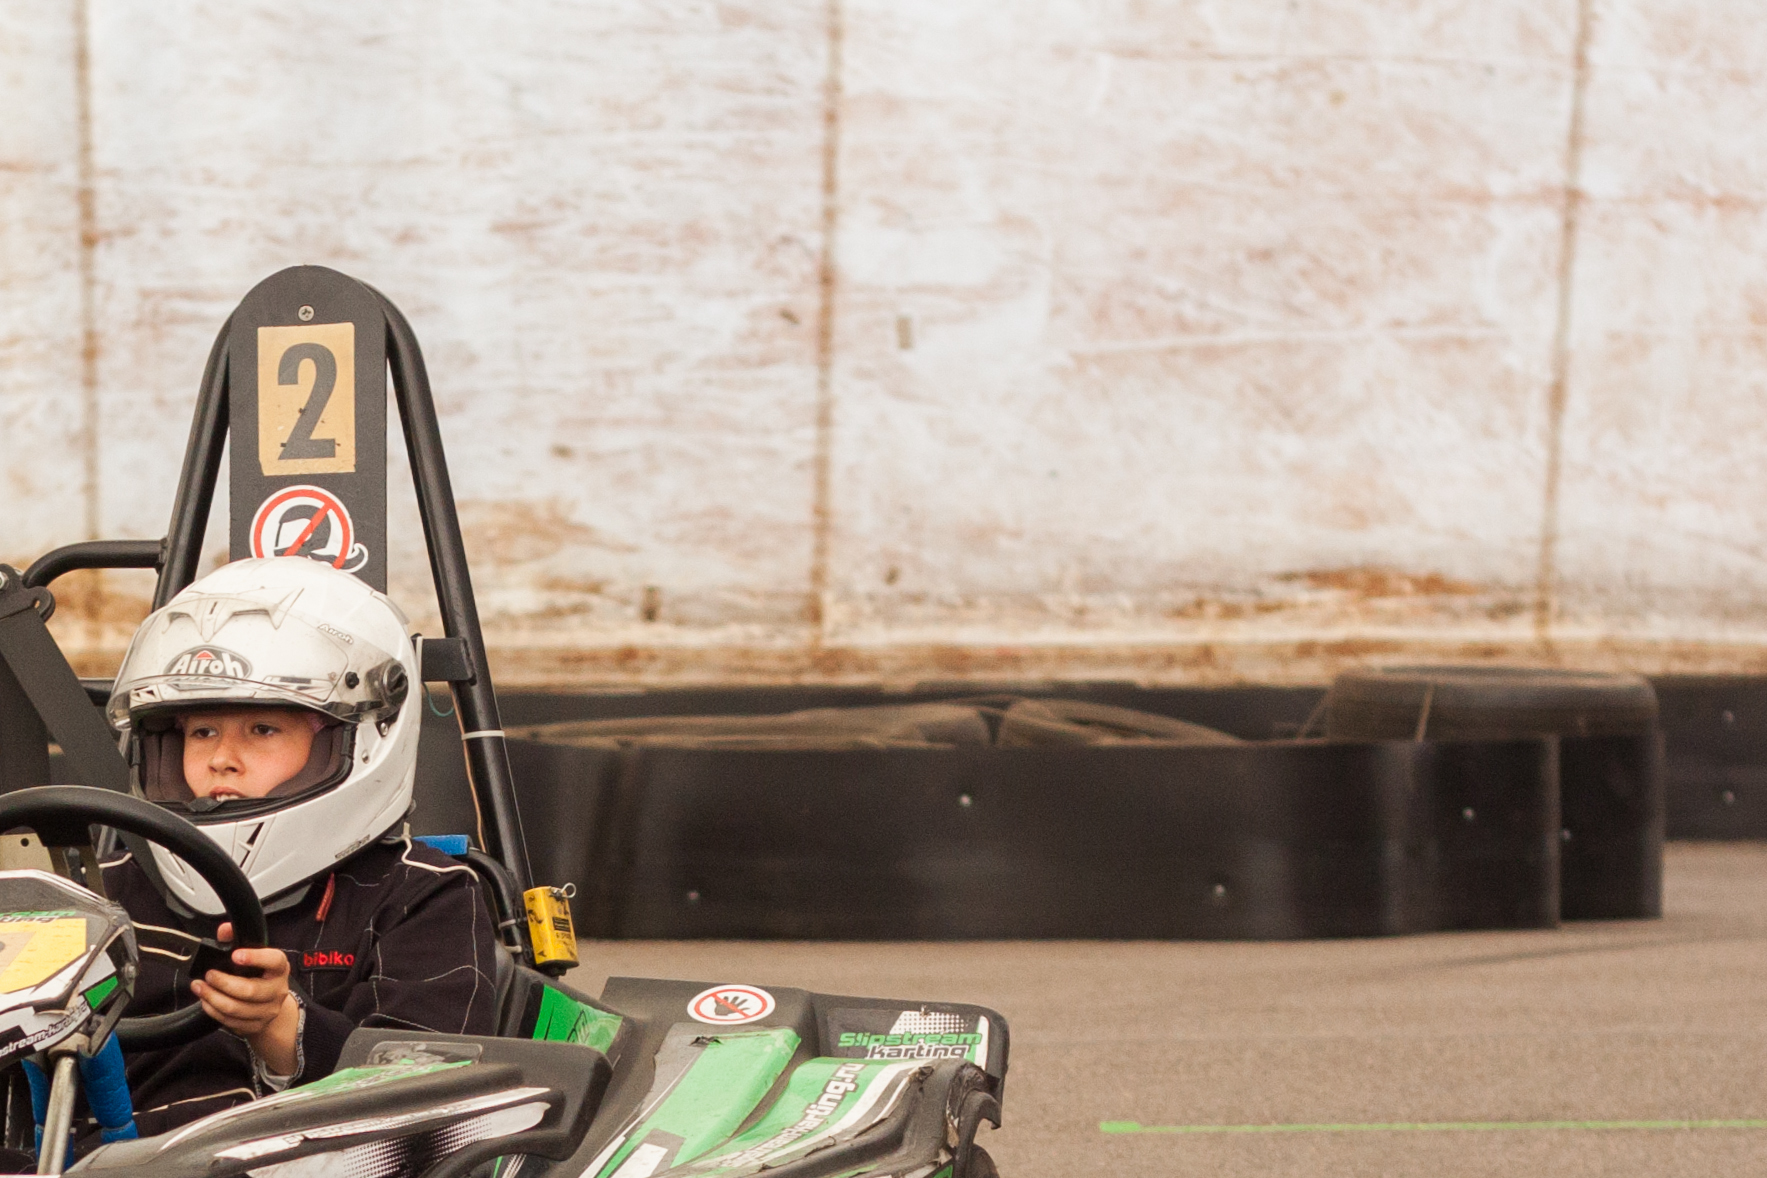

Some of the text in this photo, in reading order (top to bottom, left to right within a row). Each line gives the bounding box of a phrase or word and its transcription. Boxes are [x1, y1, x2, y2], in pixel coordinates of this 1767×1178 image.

[277, 342, 337, 460] 2
[318, 623, 354, 645] Airoh
[171, 652, 245, 678] Airoh
[837, 1031, 983, 1050] Slipstream
[865, 1044, 969, 1059] karting
